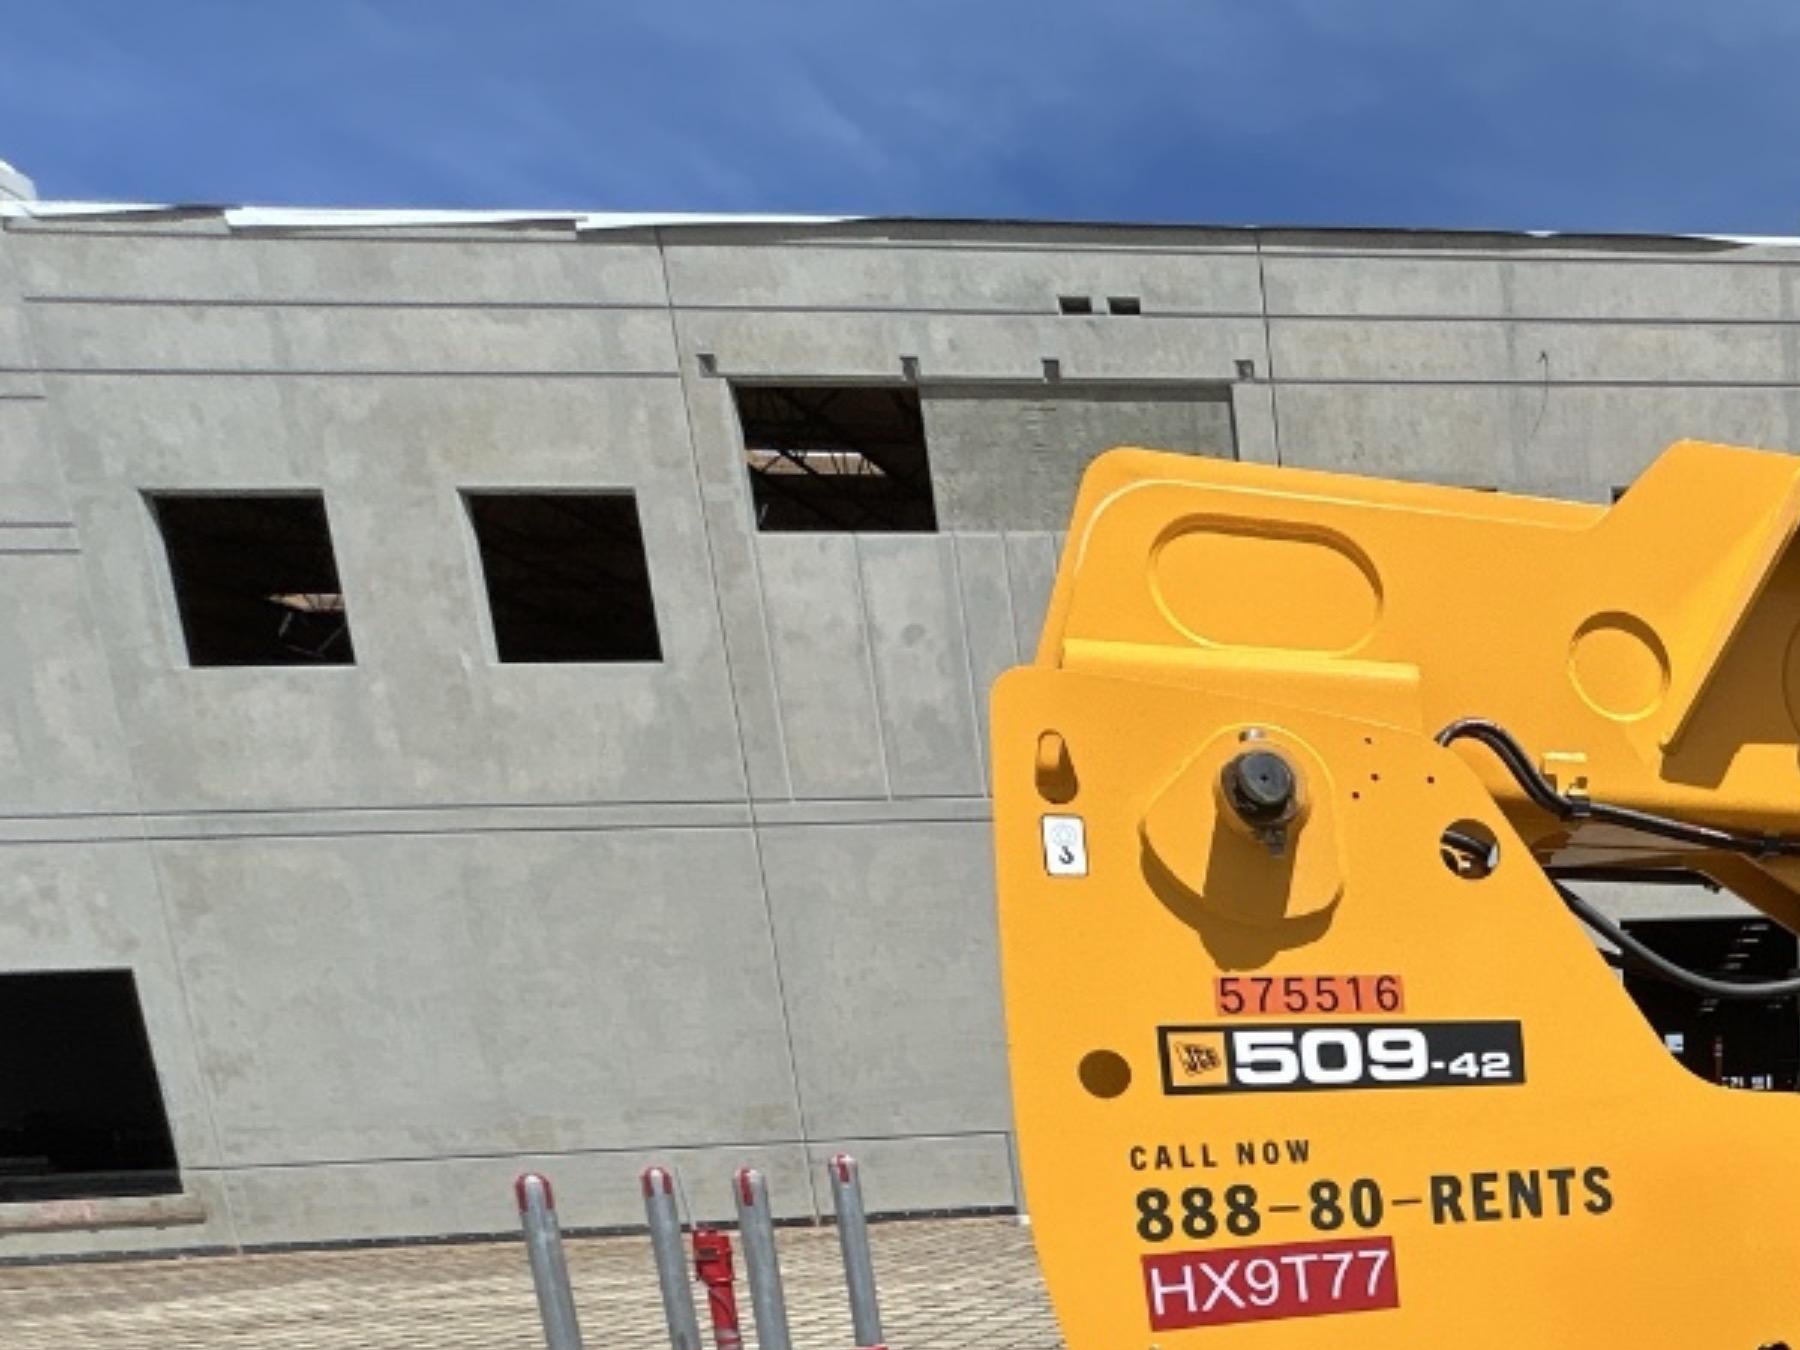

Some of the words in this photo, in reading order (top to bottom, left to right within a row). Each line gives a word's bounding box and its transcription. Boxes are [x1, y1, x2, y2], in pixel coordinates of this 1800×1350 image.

[1219, 975, 1400, 1014] 575516
[1232, 1028, 1512, 1085] 509-42
[1130, 1144, 1218, 1171] CALL
[1236, 1139, 1311, 1166] NOW
[1135, 1166, 1614, 1242] 888-80-RENTS
[1150, 1249, 1390, 1316] HX9T77
